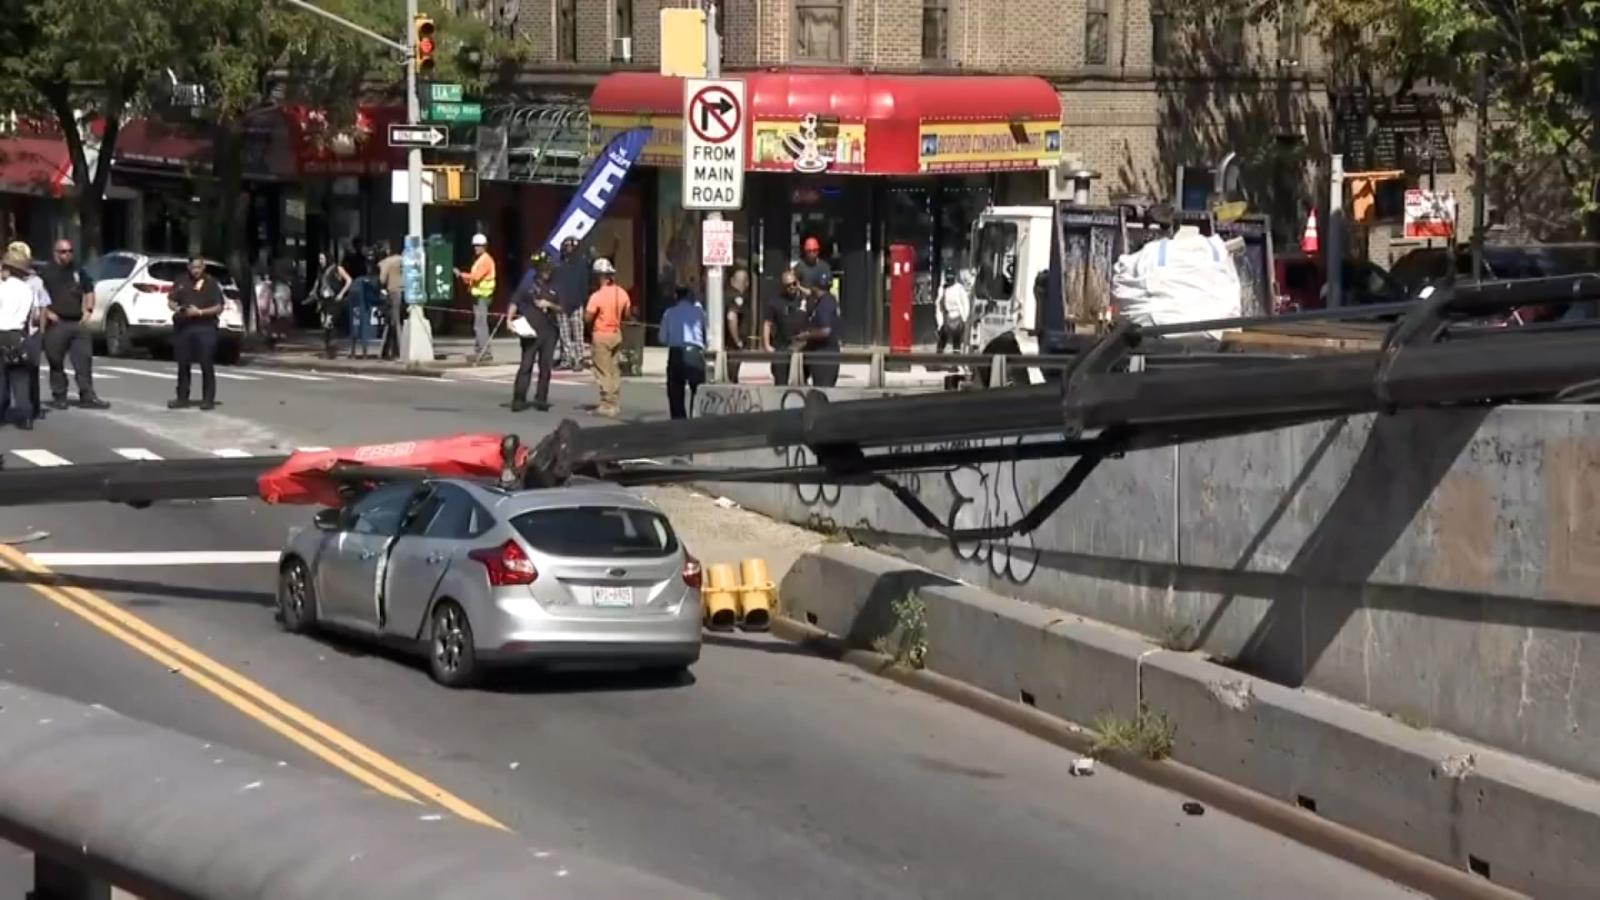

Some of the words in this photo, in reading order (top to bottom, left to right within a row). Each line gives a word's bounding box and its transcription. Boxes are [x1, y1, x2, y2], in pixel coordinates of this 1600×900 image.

[397, 131, 413, 139] ONE
[421, 131, 438, 139] WAY
[693, 146, 735, 161] FROM
[694, 167, 734, 181] MAIN
[692, 187, 735, 202] ROAD
